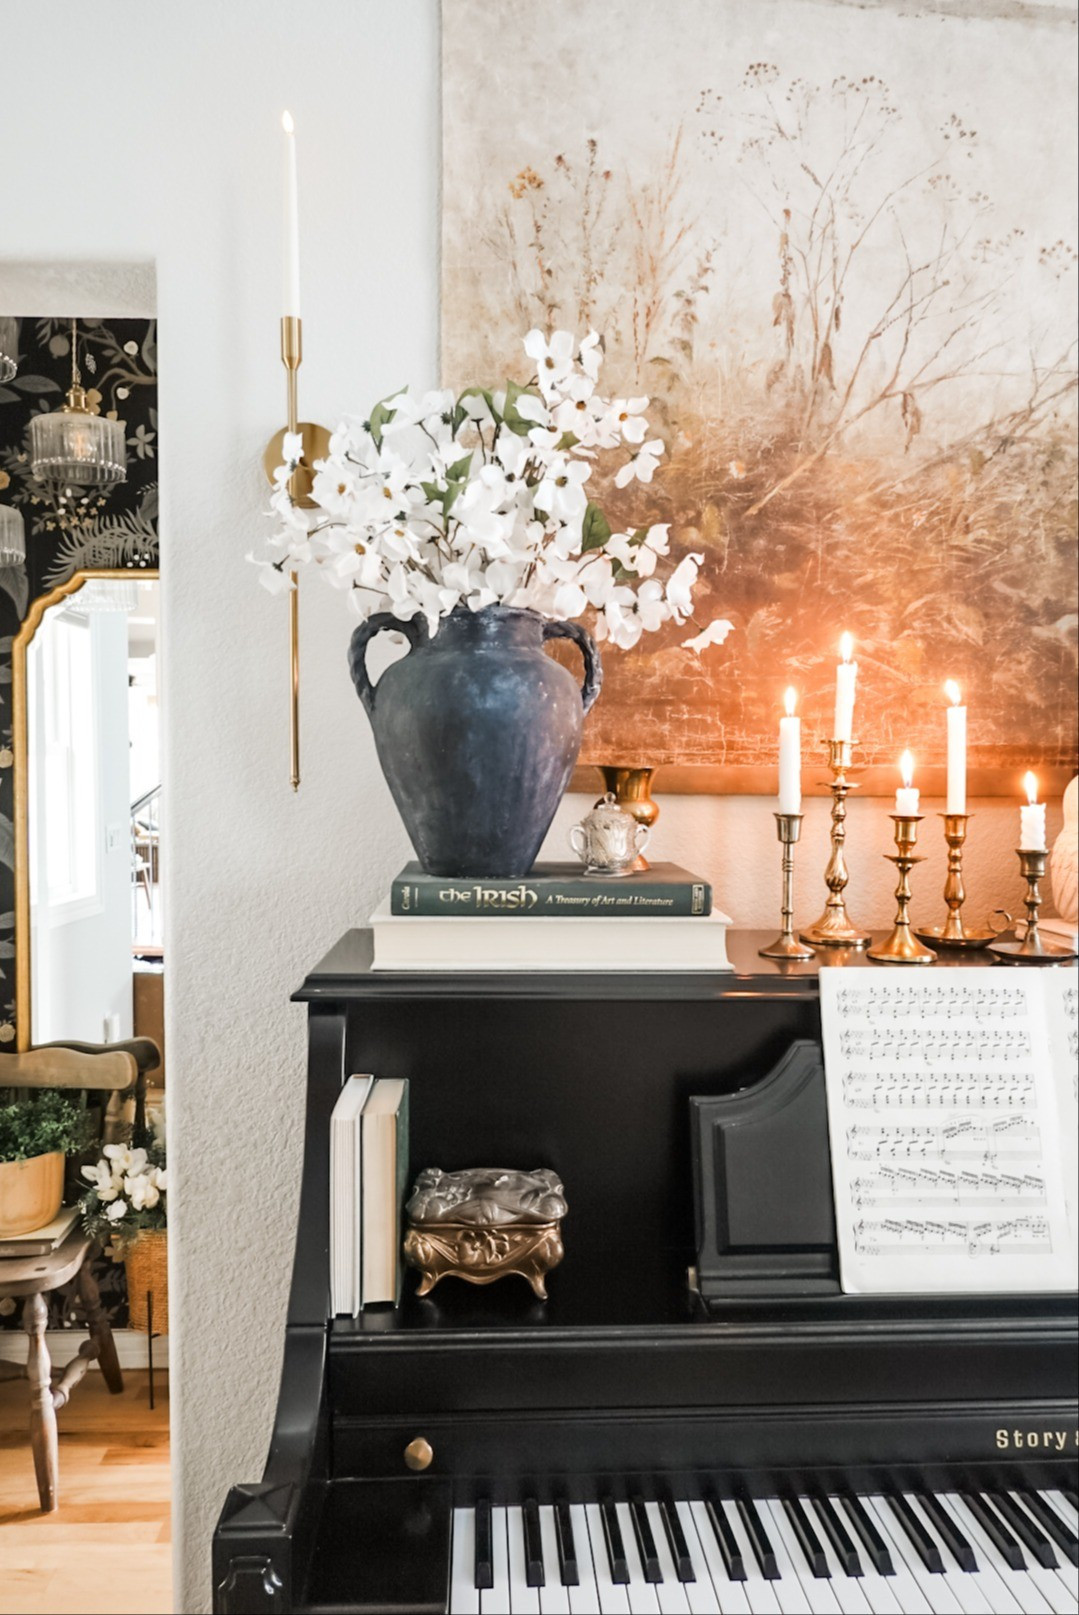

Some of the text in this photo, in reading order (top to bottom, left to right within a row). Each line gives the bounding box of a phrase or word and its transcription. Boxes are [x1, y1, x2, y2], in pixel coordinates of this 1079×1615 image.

[545, 894, 673, 907] A Treasury of Art and Literature
[996, 1429, 1067, 1451] Story
